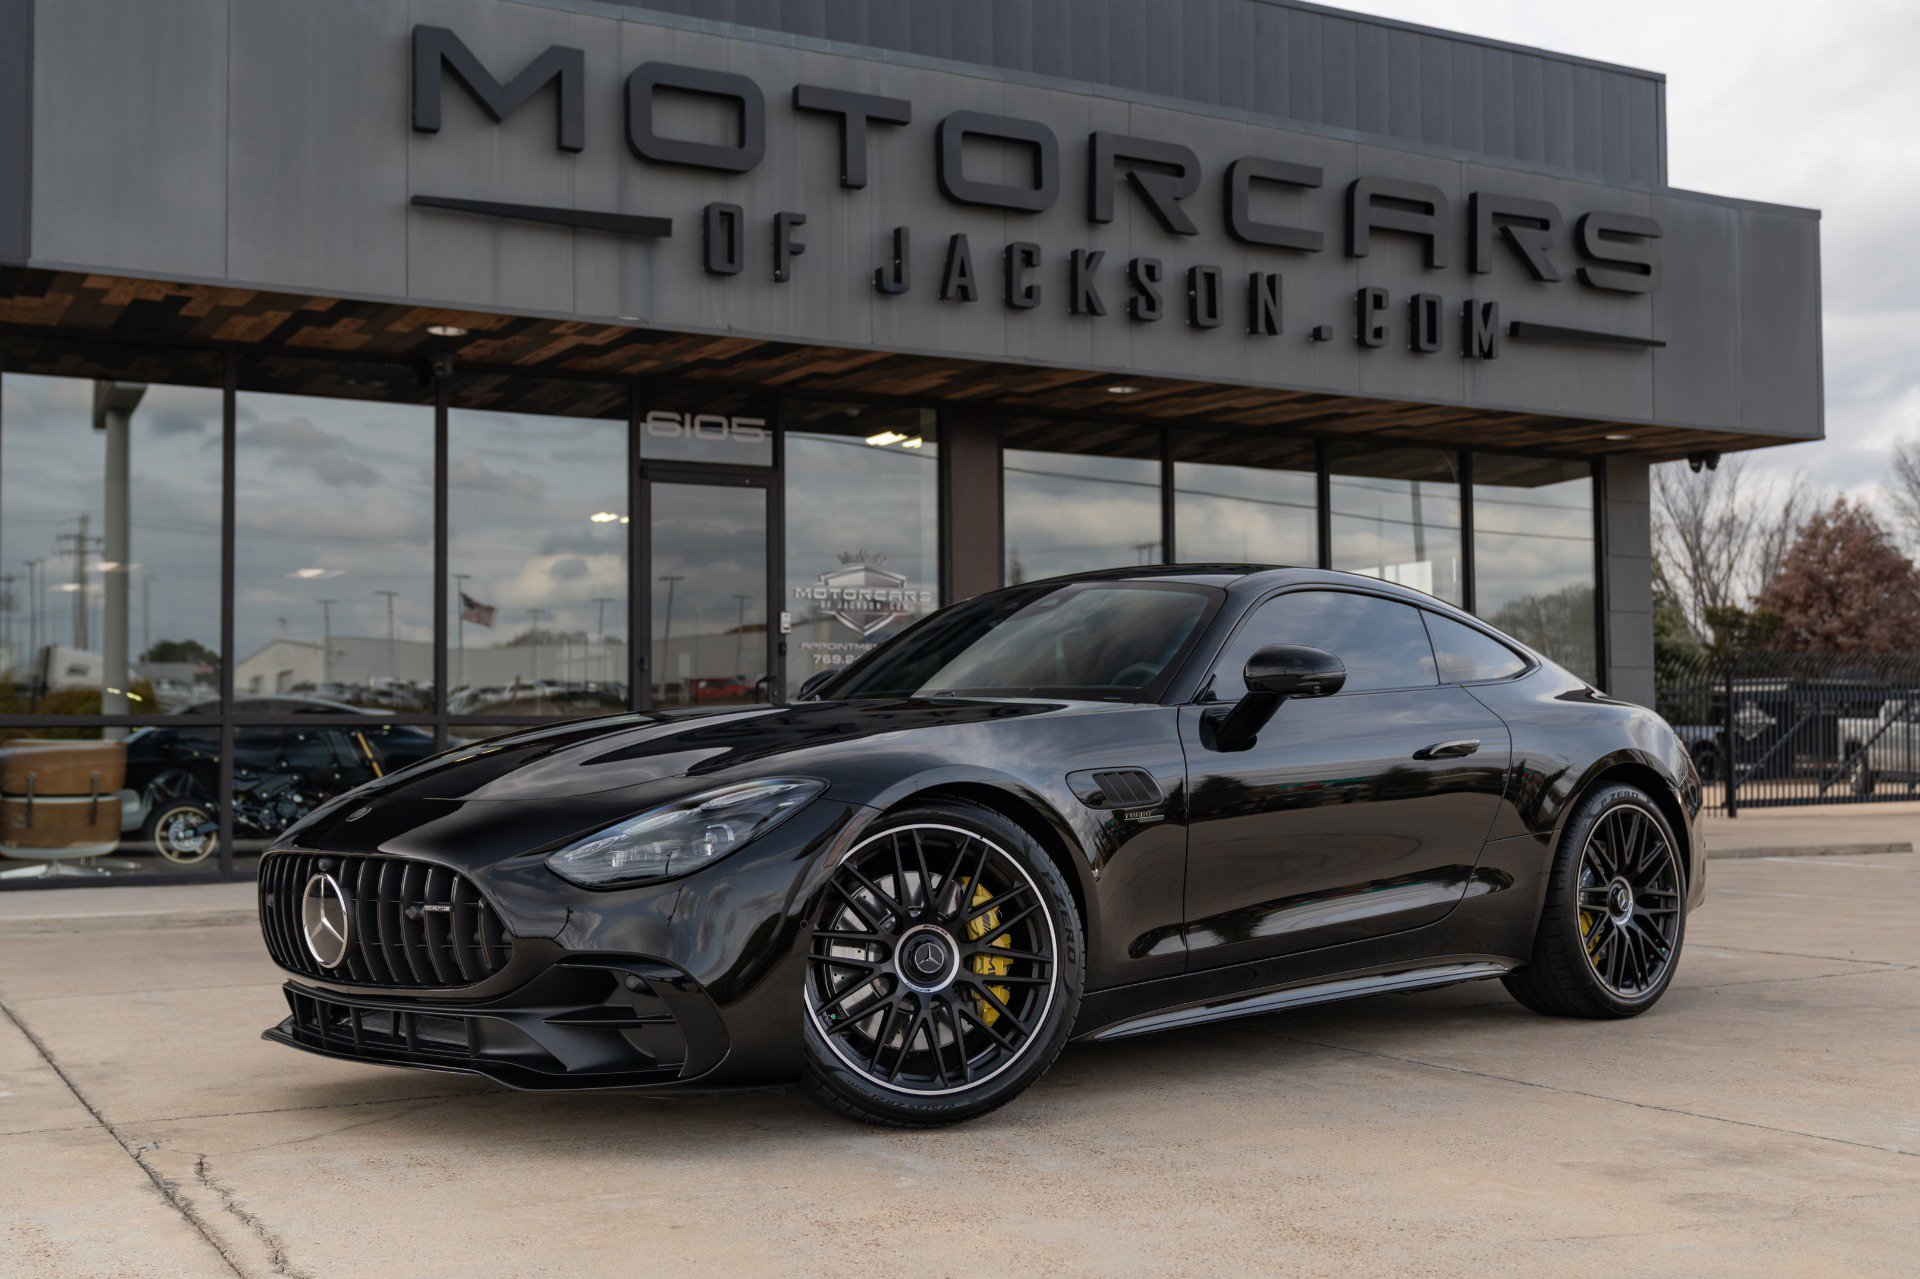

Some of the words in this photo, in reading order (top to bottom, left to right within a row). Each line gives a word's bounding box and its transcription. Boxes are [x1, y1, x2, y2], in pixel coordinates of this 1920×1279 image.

[412, 24, 1663, 293] MOTORCARS
[702, 202, 806, 283] OF
[646, 410, 766, 443] 6105
[794, 587, 932, 602] MOTORCARS
[1052, 892, 1076, 965] ZERO
